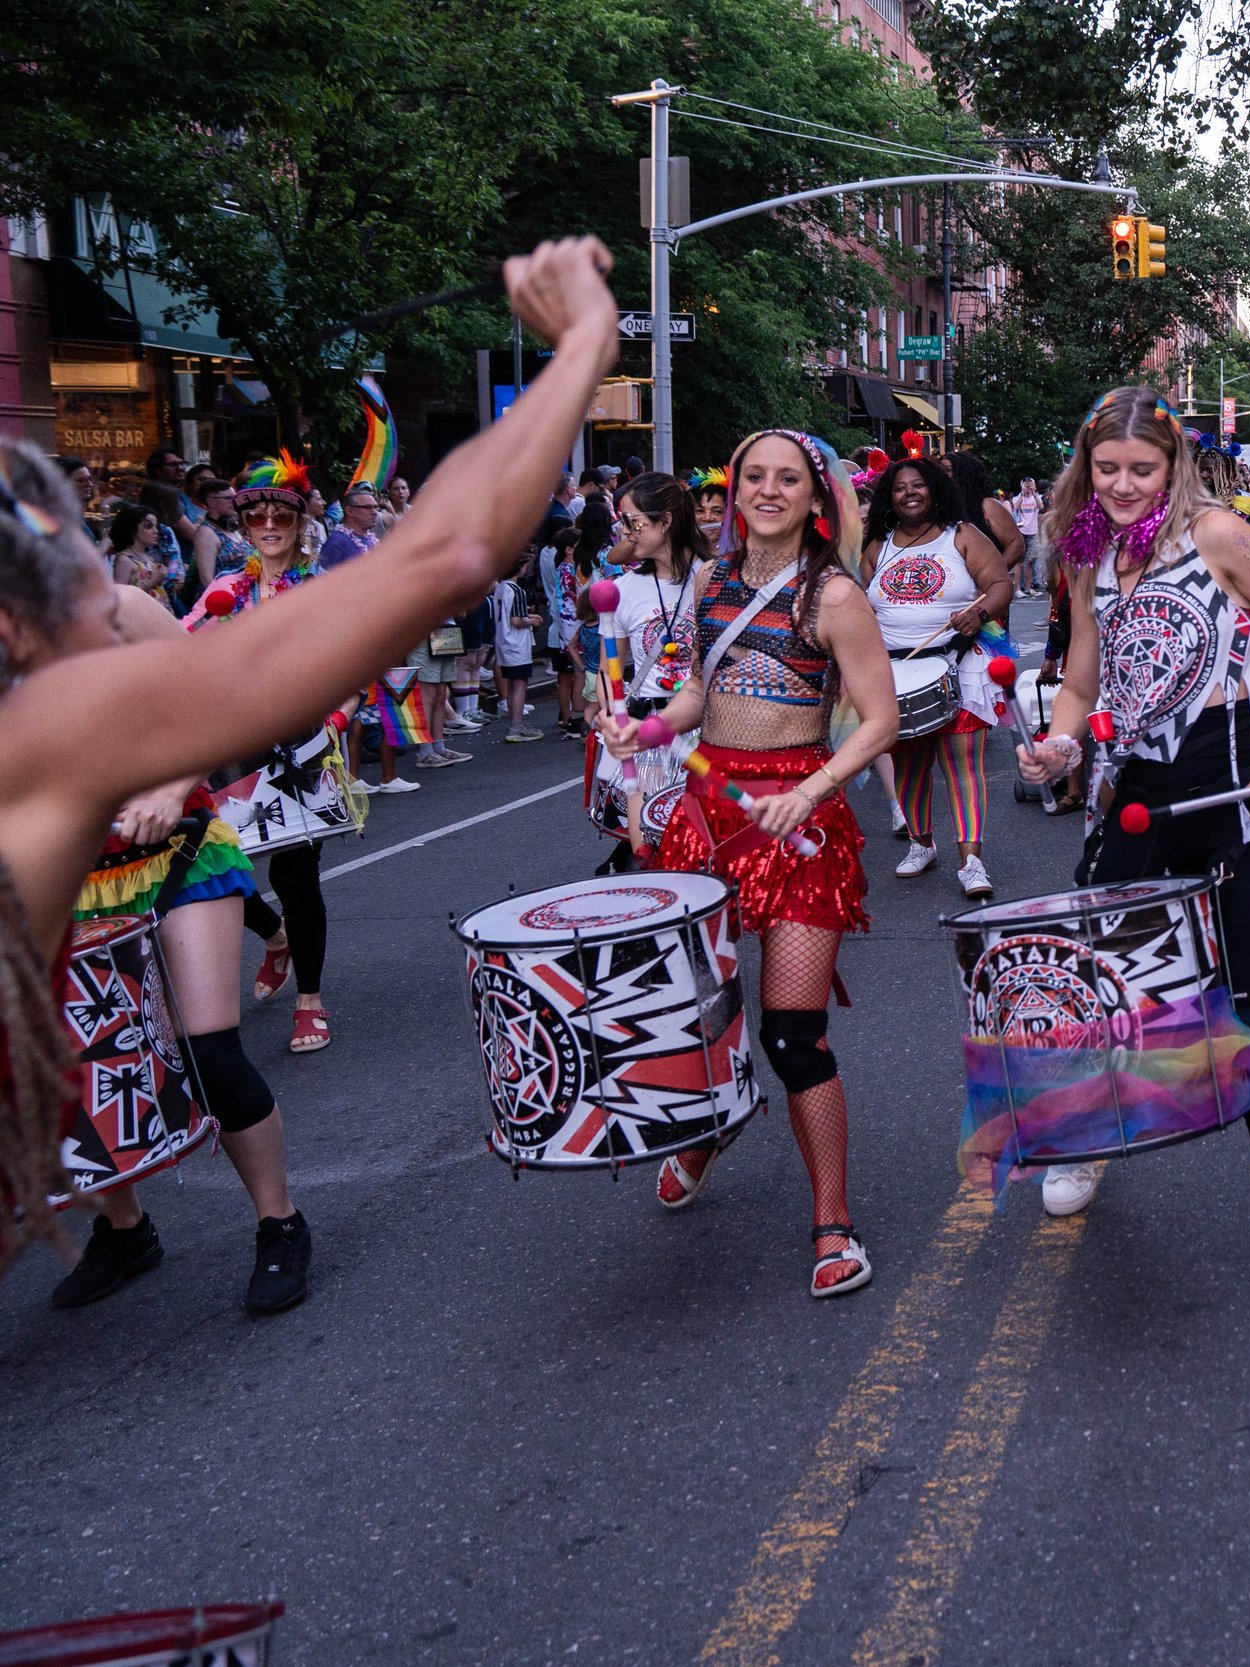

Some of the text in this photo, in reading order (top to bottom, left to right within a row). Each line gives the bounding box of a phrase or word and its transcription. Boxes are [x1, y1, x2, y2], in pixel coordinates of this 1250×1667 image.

[626, 321, 651, 332] ONE
[908, 336, 932, 348] Degraw
[65, 430, 145, 448] SALSA BAR
[1174, 687, 1200, 714] GREECE
[551, 1022, 576, 1098] REGGAE
